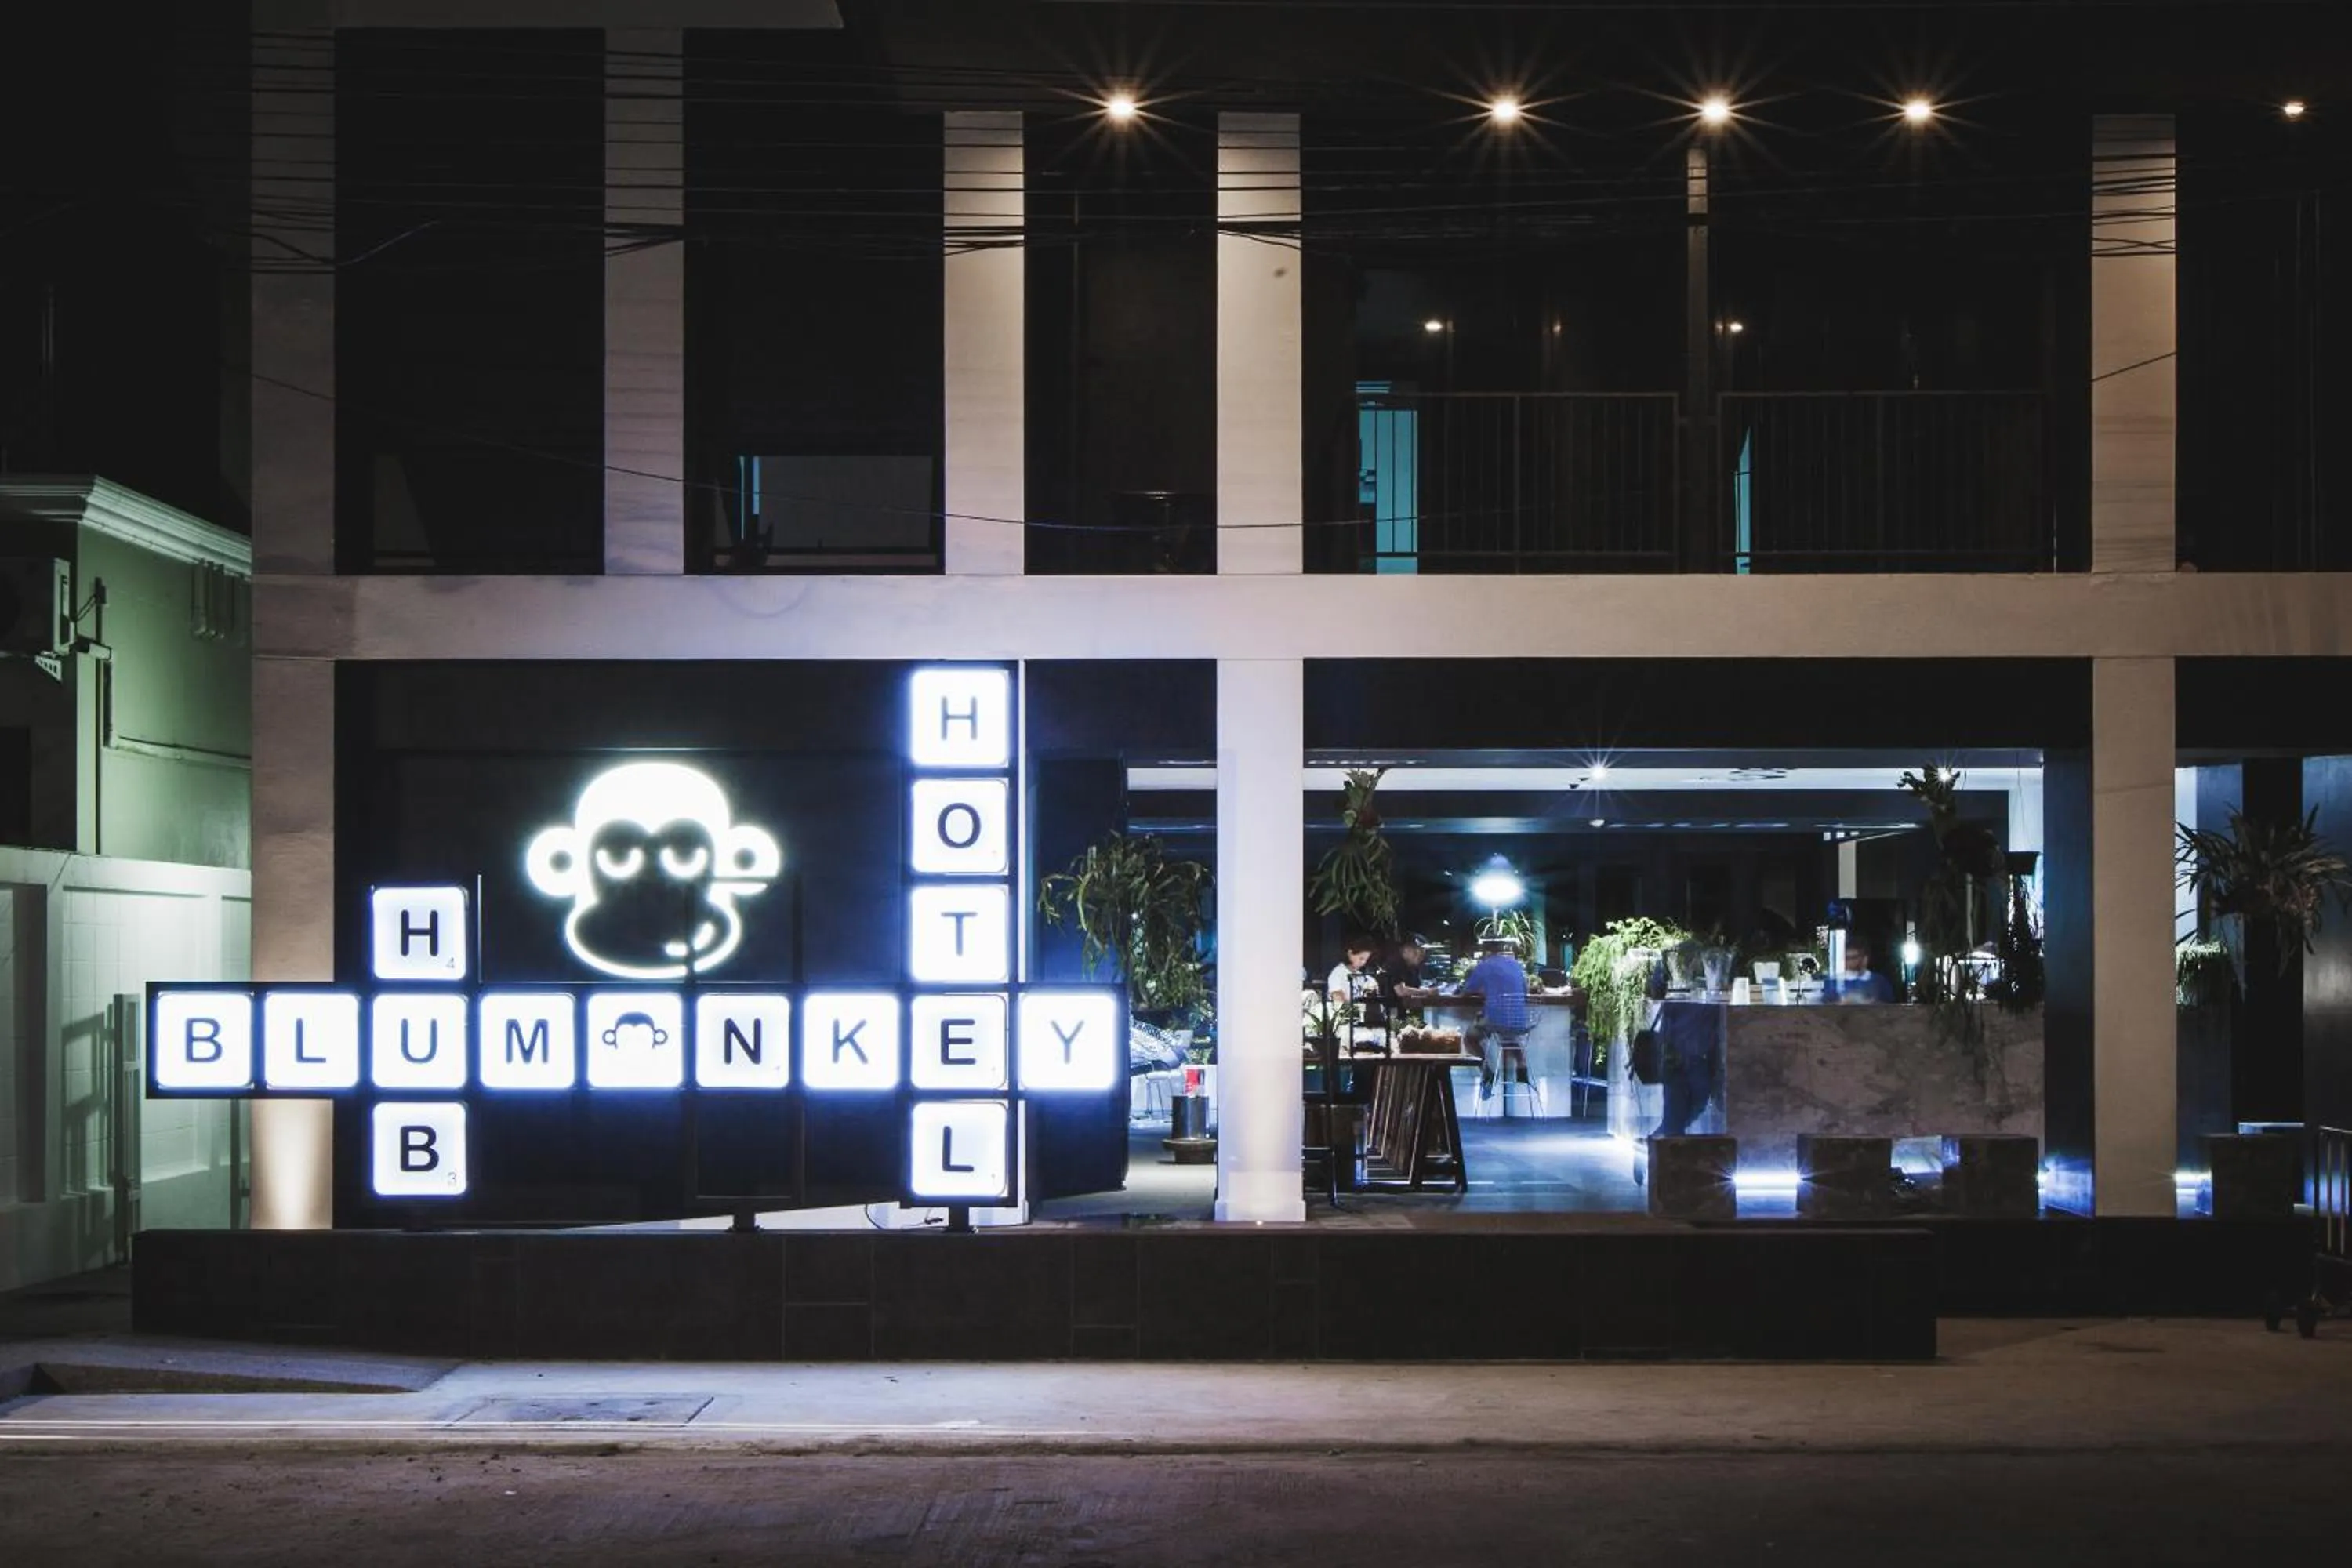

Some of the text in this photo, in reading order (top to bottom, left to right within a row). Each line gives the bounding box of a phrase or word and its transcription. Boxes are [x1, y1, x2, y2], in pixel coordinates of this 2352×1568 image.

[184, 1017, 1084, 1065] BLUMNKEY
[400, 909, 439, 1172] HUB
[938, 696, 982, 1173] HOTEL
